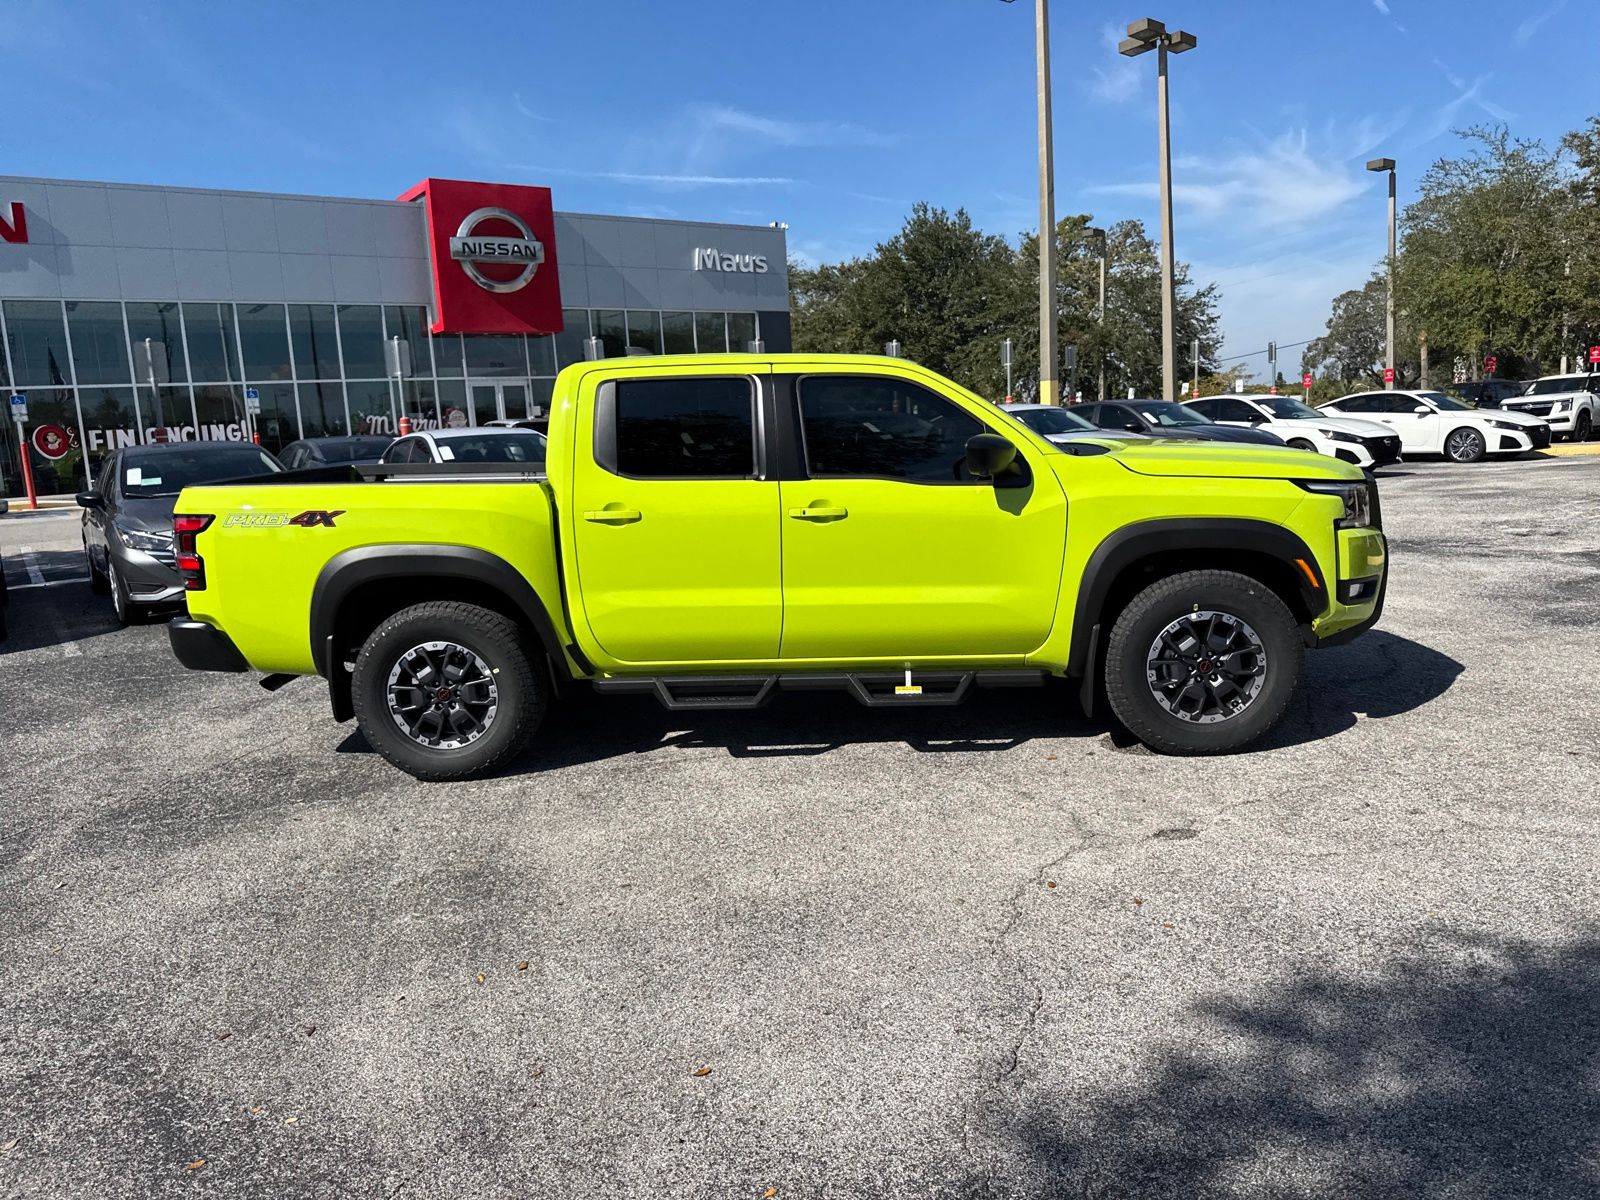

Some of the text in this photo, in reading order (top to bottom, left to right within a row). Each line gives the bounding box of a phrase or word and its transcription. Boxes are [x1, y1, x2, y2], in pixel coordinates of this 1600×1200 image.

[461, 242, 537, 257] NISSAN
[694, 247, 768, 273] Maus
[366, 415, 438, 435] Mrry
